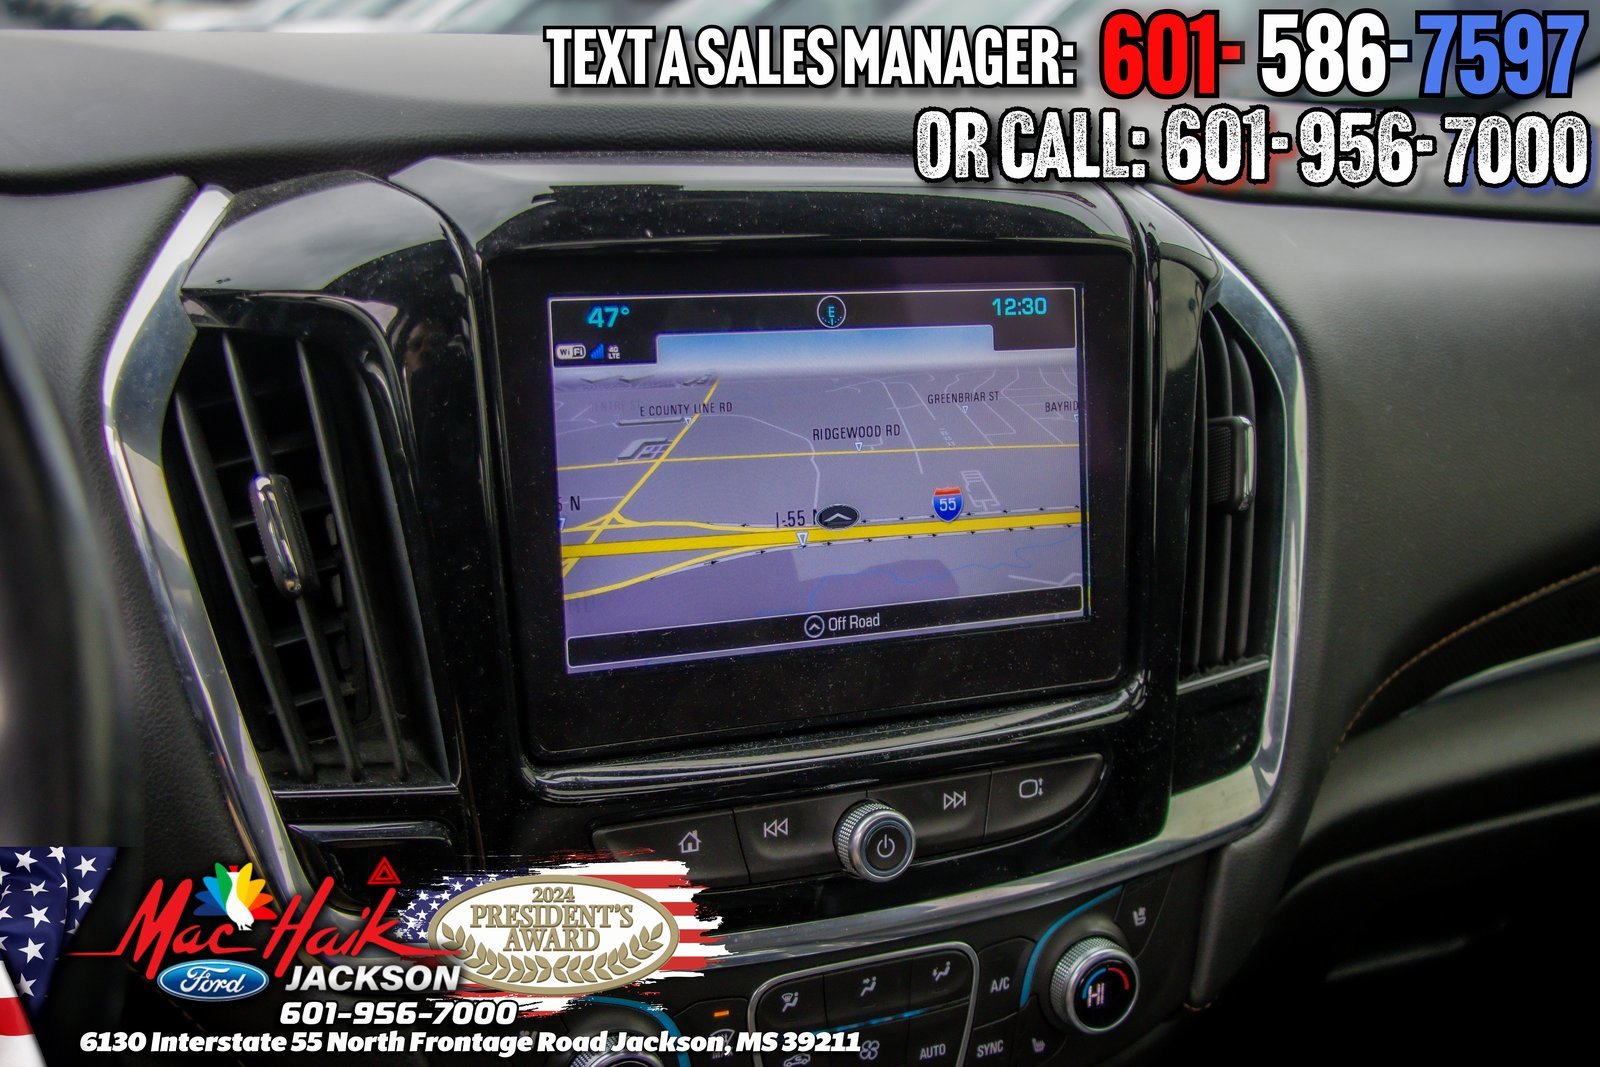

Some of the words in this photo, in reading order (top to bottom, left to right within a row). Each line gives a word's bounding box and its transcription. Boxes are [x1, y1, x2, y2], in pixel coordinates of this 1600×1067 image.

[991, 296, 1048, 316] 12:30
[586, 305, 631, 328] 47°
[927, 391, 986, 405] GREENBRIAR
[988, 390, 1000, 402] ST
[640, 407, 645, 417] E
[649, 403, 690, 416] COUNTY
[694, 402, 715, 414] LINE
[719, 401, 733, 413] RD
[812, 425, 883, 441] RIDGEWOOD
[885, 423, 901, 438] RD
[570, 495, 581, 511] N
[938, 497, 957, 512] 55
[828, 617, 847, 631] Off
[850, 612, 881, 629] Road
[990, 978, 1010, 994] A/C
[919, 1042, 946, 1060] AUTO
[976, 1040, 1004, 1058] SYNC
